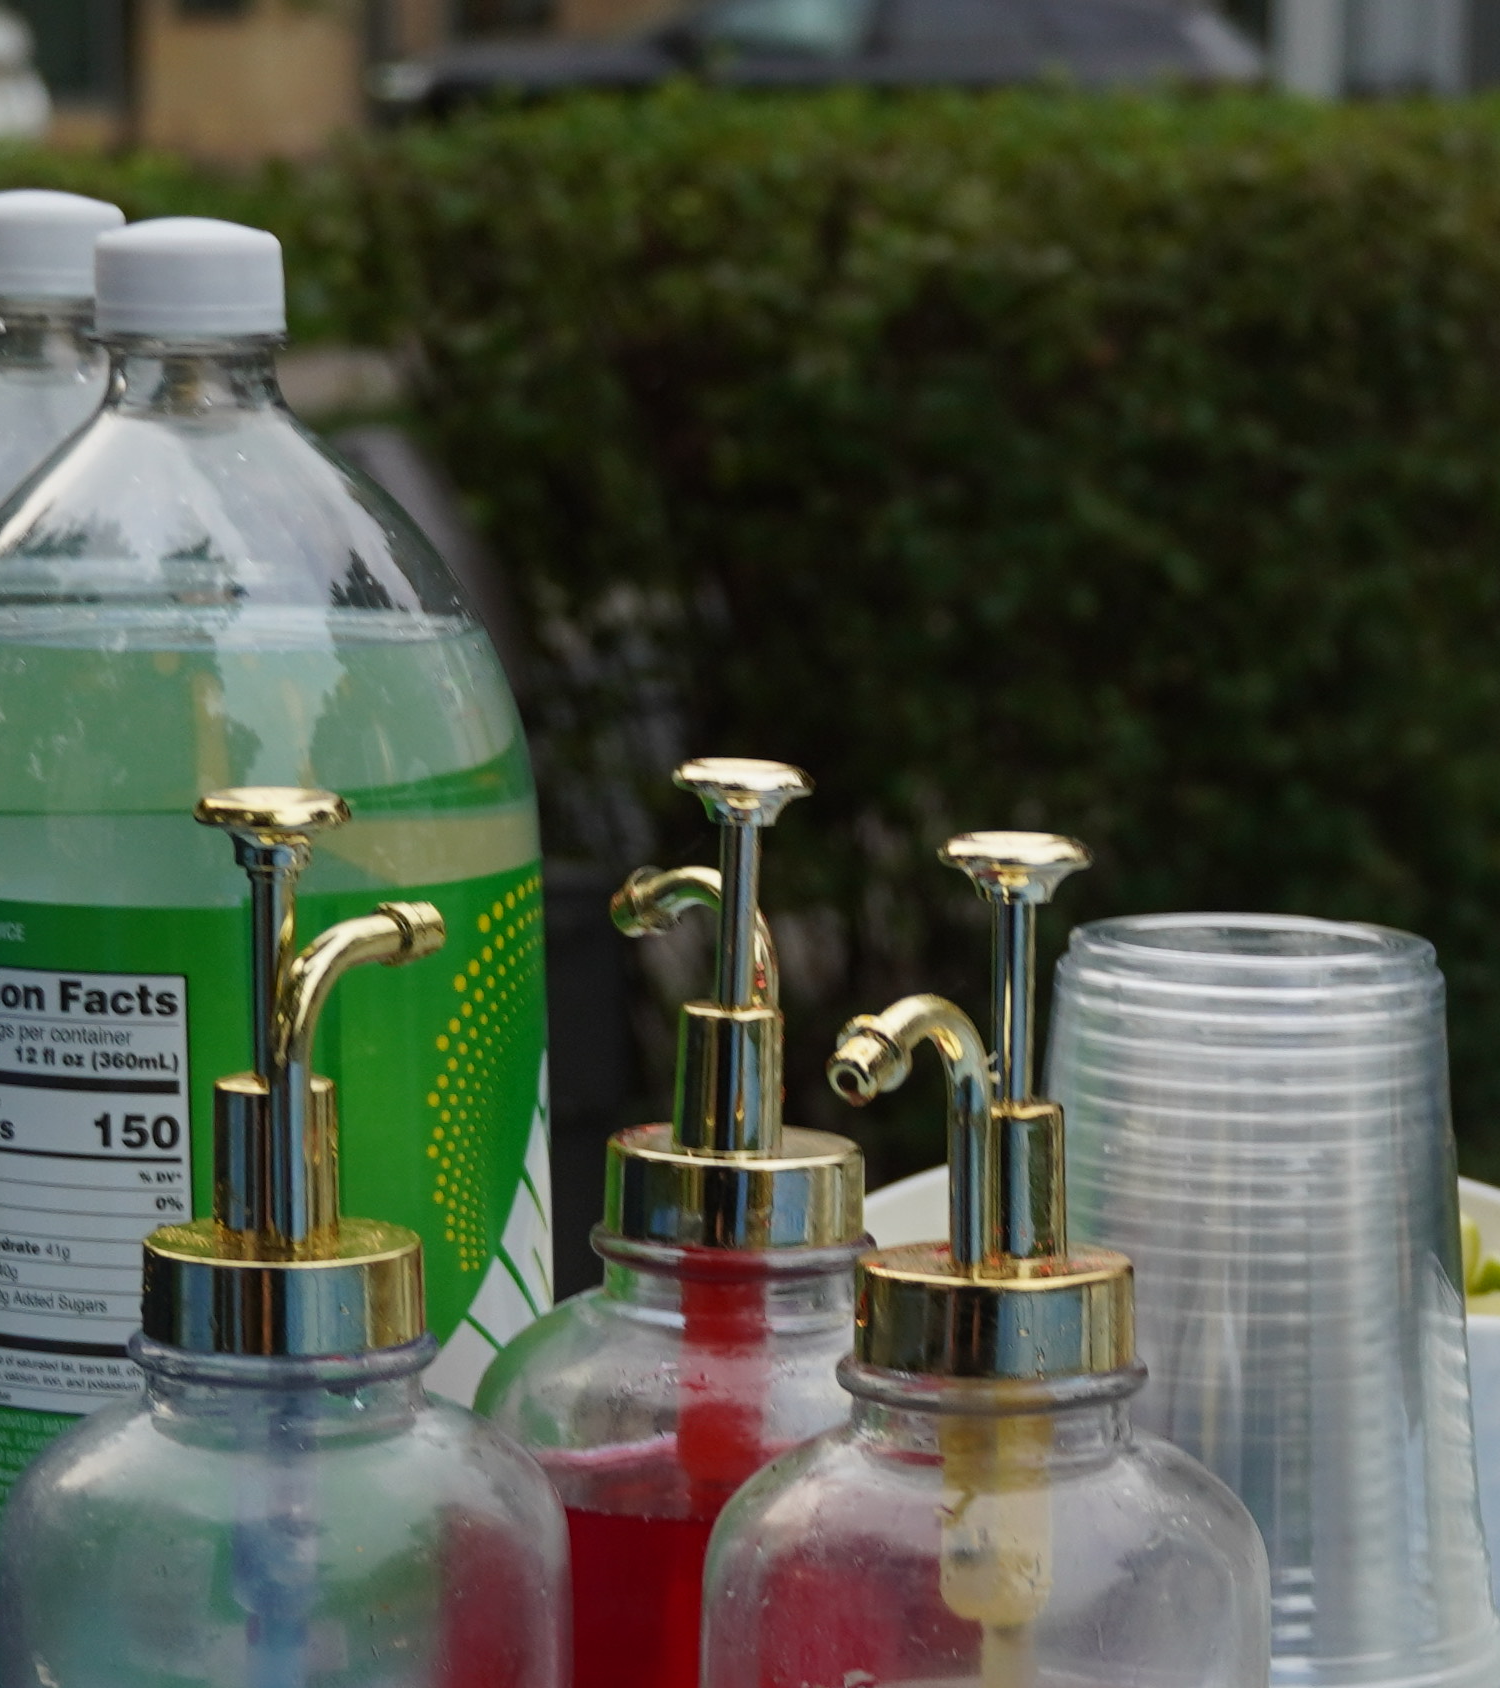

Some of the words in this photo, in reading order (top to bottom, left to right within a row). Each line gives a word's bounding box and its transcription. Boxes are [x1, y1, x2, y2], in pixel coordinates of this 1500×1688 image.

[58, 978, 179, 1017] Facts
[18, 1024, 45, 1043] per
[50, 1025, 133, 1047] container
[15, 1045, 38, 1065] 12
[42, 1047, 56, 1065] fl
[63, 1053, 85, 1068] oz
[92, 1050, 179, 1074] (360mL)
[93, 1112, 181, 1149] 150
[156, 1195, 184, 1211] 0%
[11, 1289, 54, 1310] Added
[57, 1295, 108, 1316] Sugars
